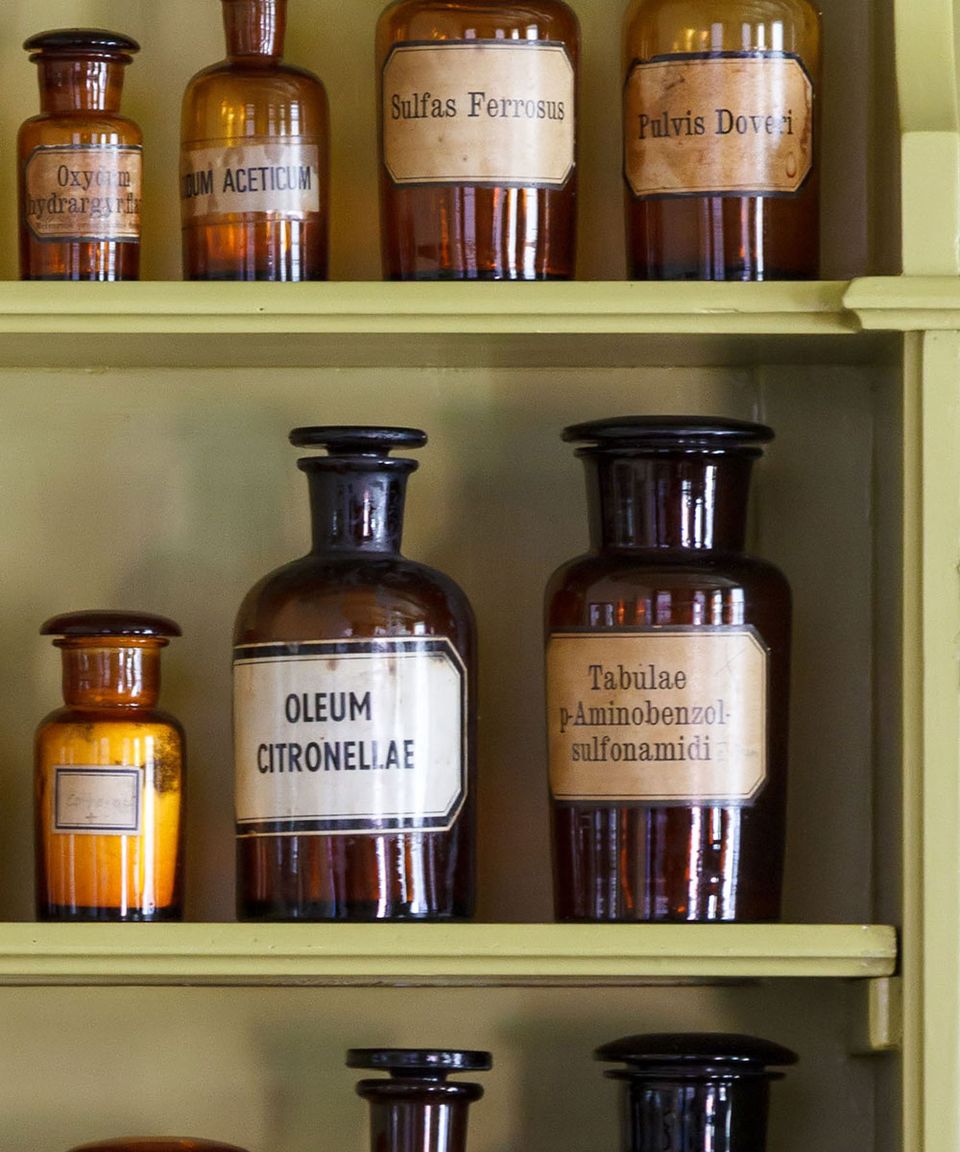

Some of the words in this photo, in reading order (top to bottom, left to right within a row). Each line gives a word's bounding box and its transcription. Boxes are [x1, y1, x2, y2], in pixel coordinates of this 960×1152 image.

[391, 92, 457, 120] Sulfas
[467, 91, 565, 121] Ferrosus
[638, 110, 706, 140] Pulvis
[715, 108, 794, 135] Doveri
[57, 164, 131, 192] Oxydm
[223, 166, 312, 193] ACETICUM
[589, 664, 687, 690] Tabulae
[285, 691, 372, 723] OLEUM
[559, 699, 732, 734] p-Aminobenzol-
[257, 739, 415, 774] CITRONELLAE
[571, 735, 713, 762] sulfonamidi
